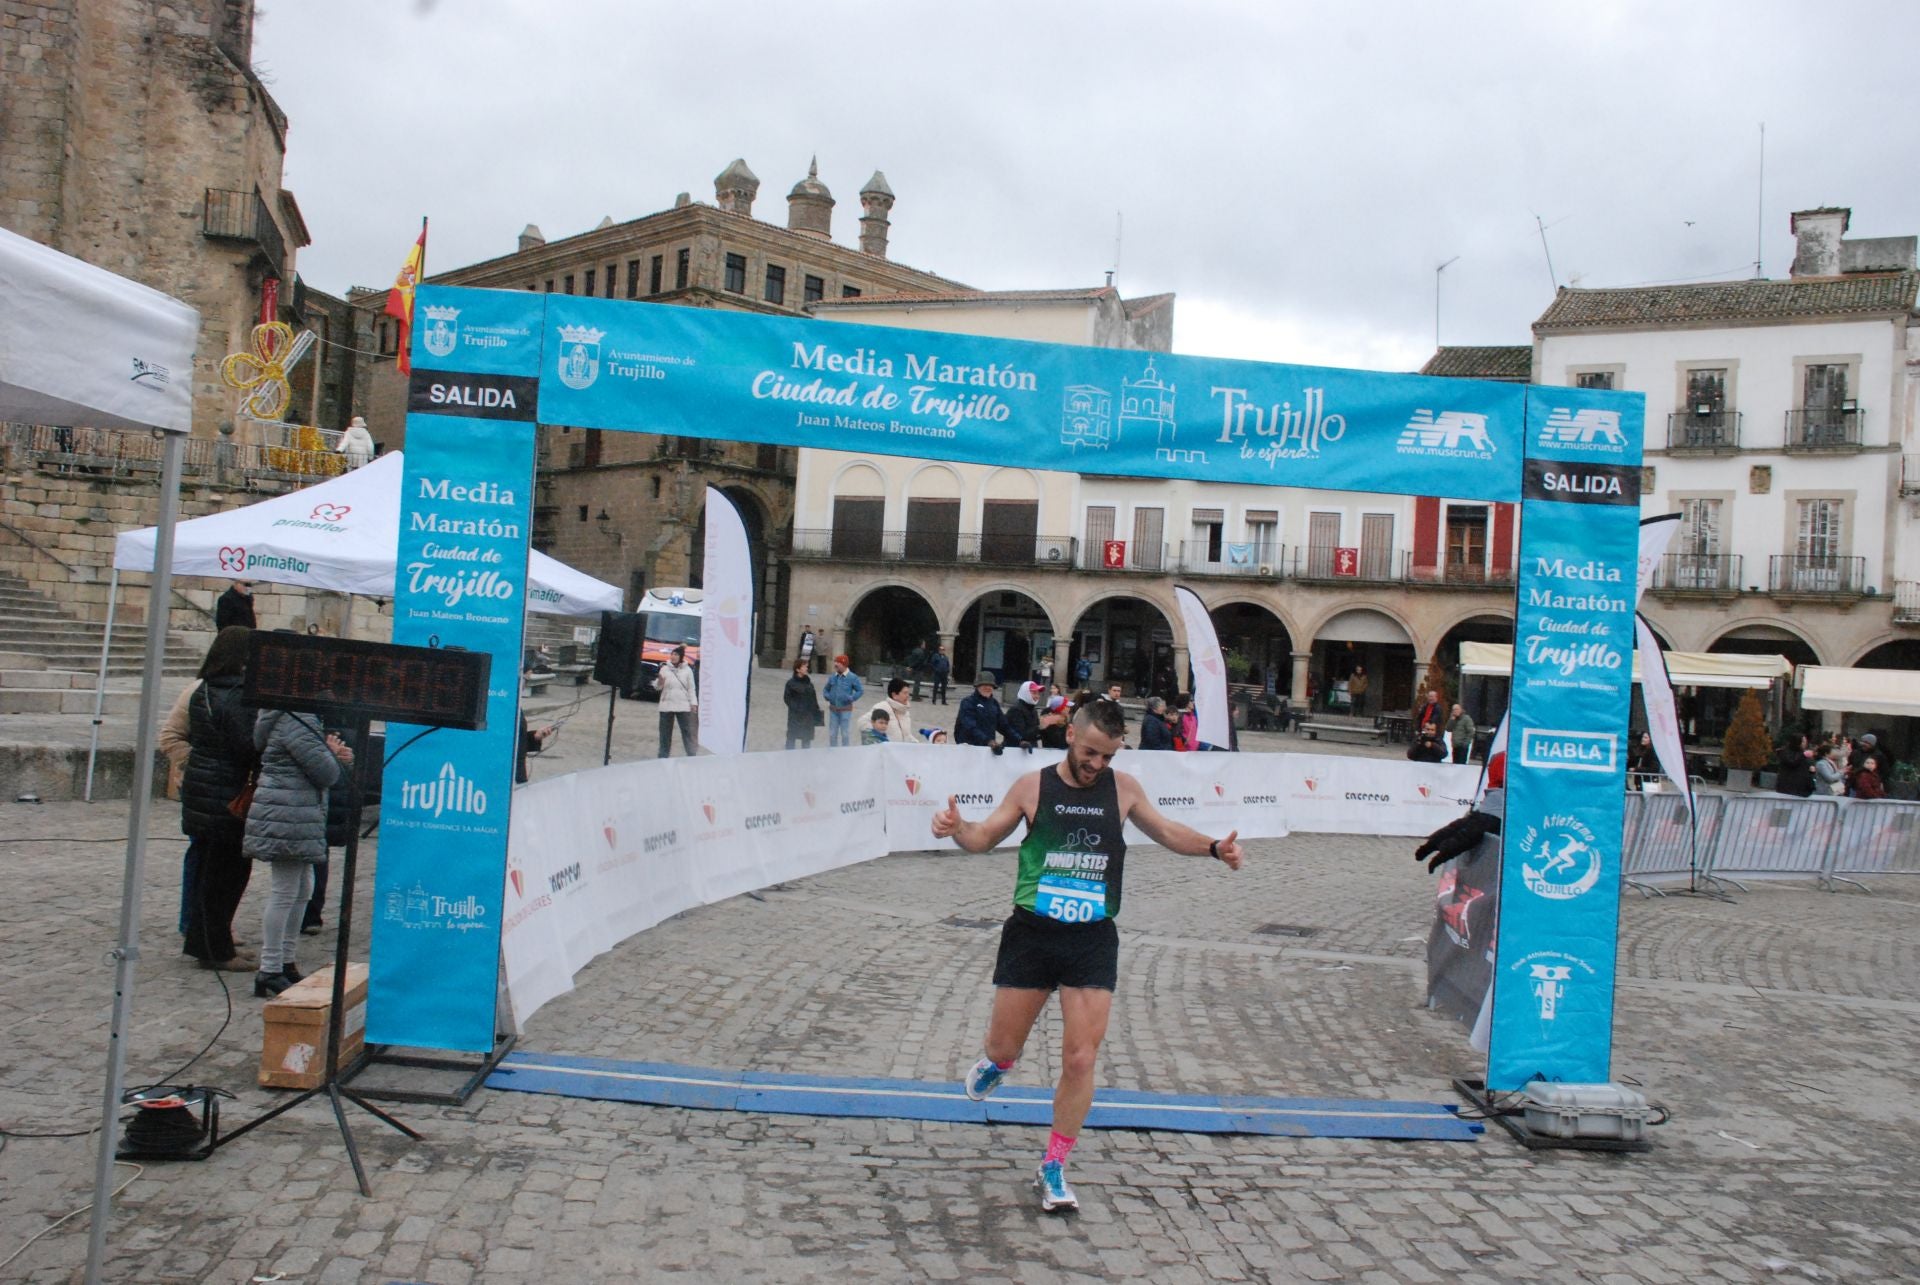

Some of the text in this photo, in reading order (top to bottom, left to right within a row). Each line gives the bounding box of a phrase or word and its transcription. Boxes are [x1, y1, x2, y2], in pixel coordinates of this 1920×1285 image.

[463, 324, 531, 336] Ayuntamiento de
[463, 334, 508, 348] Trujillo
[608, 349, 696, 366] Ayuntamiento de
[790, 341, 1038, 392] Media Maratón
[607, 361, 666, 381] Trujillo
[429, 383, 517, 409] SALIDA
[751, 369, 1011, 428] Ciudad de Trujillo
[796, 412, 957, 439] Juan Mateos Broncano
[1210, 386, 1347, 452] Trujillo
[1240, 439, 1256, 460] te
[1396, 445, 1493, 460] www.musicrun.es
[1537, 440, 1624, 453] www.musicrun.es
[418, 477, 515, 506] Media
[1543, 472, 1622, 495] SALIDA
[271, 519, 348, 533] primaflor
[410, 511, 520, 539] Maratón
[247, 554, 311, 573] primaflor
[422, 541, 503, 564] Ciudad de
[1535, 556, 1622, 583] Media
[406, 562, 514, 608] Trujillo
[1528, 588, 1627, 613] Maratón
[409, 608, 510, 624] Juan Mateos Broncano
[1538, 616, 1611, 636] Ciudad de
[1525, 635, 1622, 676] Trujillo
[1535, 740, 1603, 761] HABLA
[402, 761, 488, 818] trujillo
[1087, 806, 1105, 817] MAX
[1520, 813, 1596, 853] Club Atletismo
[1527, 877, 1583, 896] TRUJILLO
[431, 895, 486, 920] Trujillo
[1047, 896, 1094, 923] 560
[1544, 997, 1553, 1012] S
